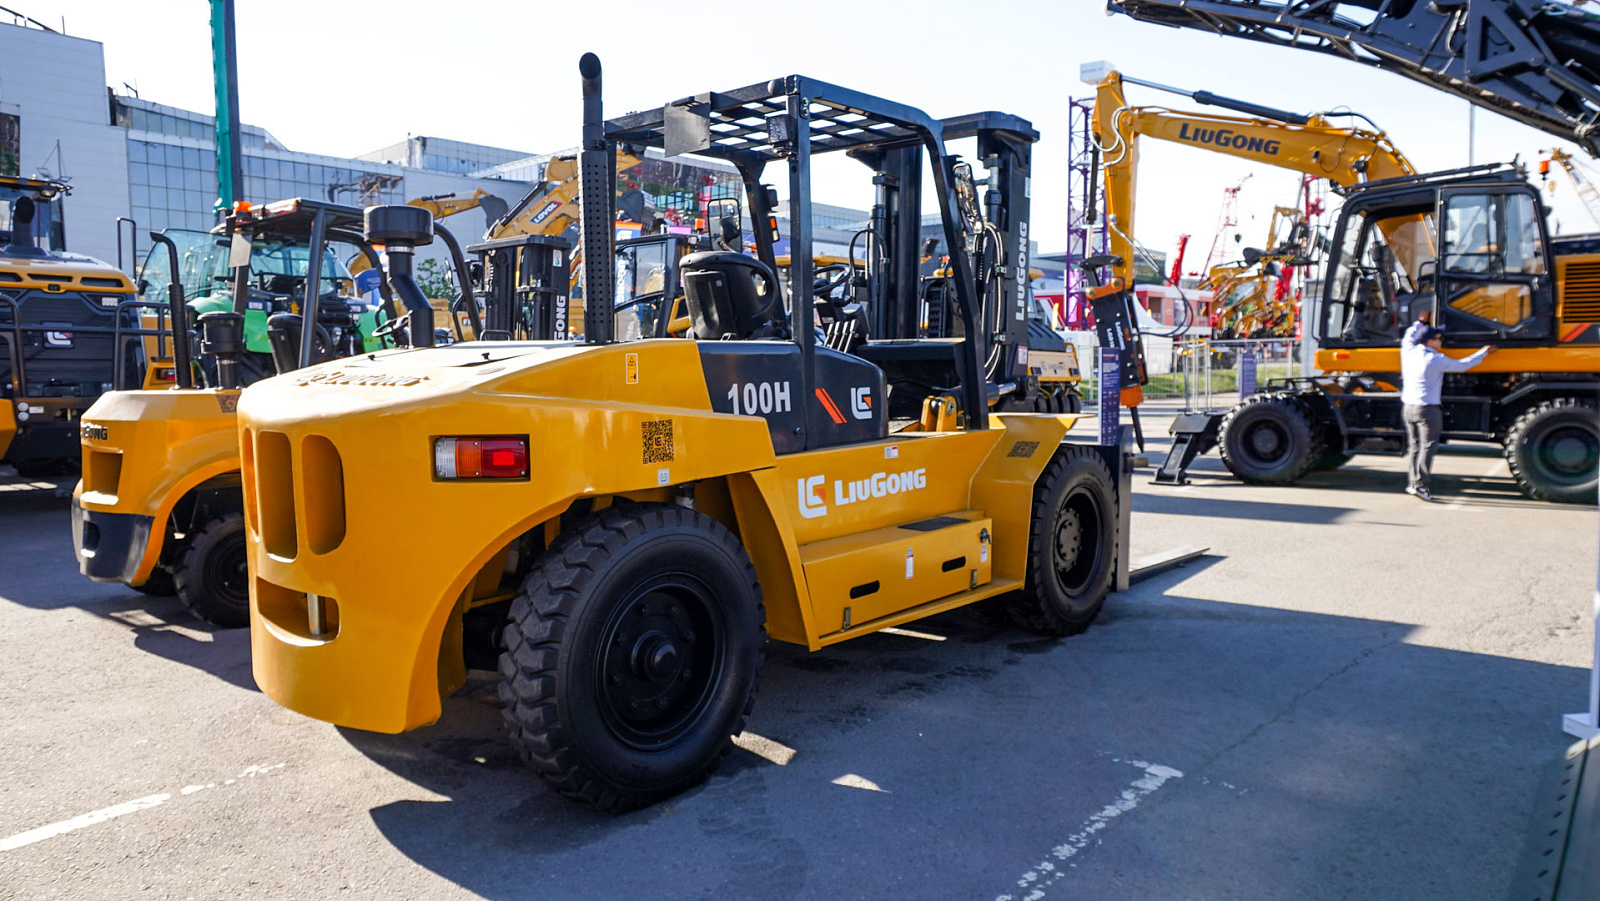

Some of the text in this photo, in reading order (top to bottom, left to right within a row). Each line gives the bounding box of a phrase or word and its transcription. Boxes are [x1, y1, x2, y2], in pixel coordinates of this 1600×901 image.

[533, 203, 558, 224] LOVOL
[1015, 221, 1028, 321] LIUGONG
[728, 381, 791, 415] 100H
